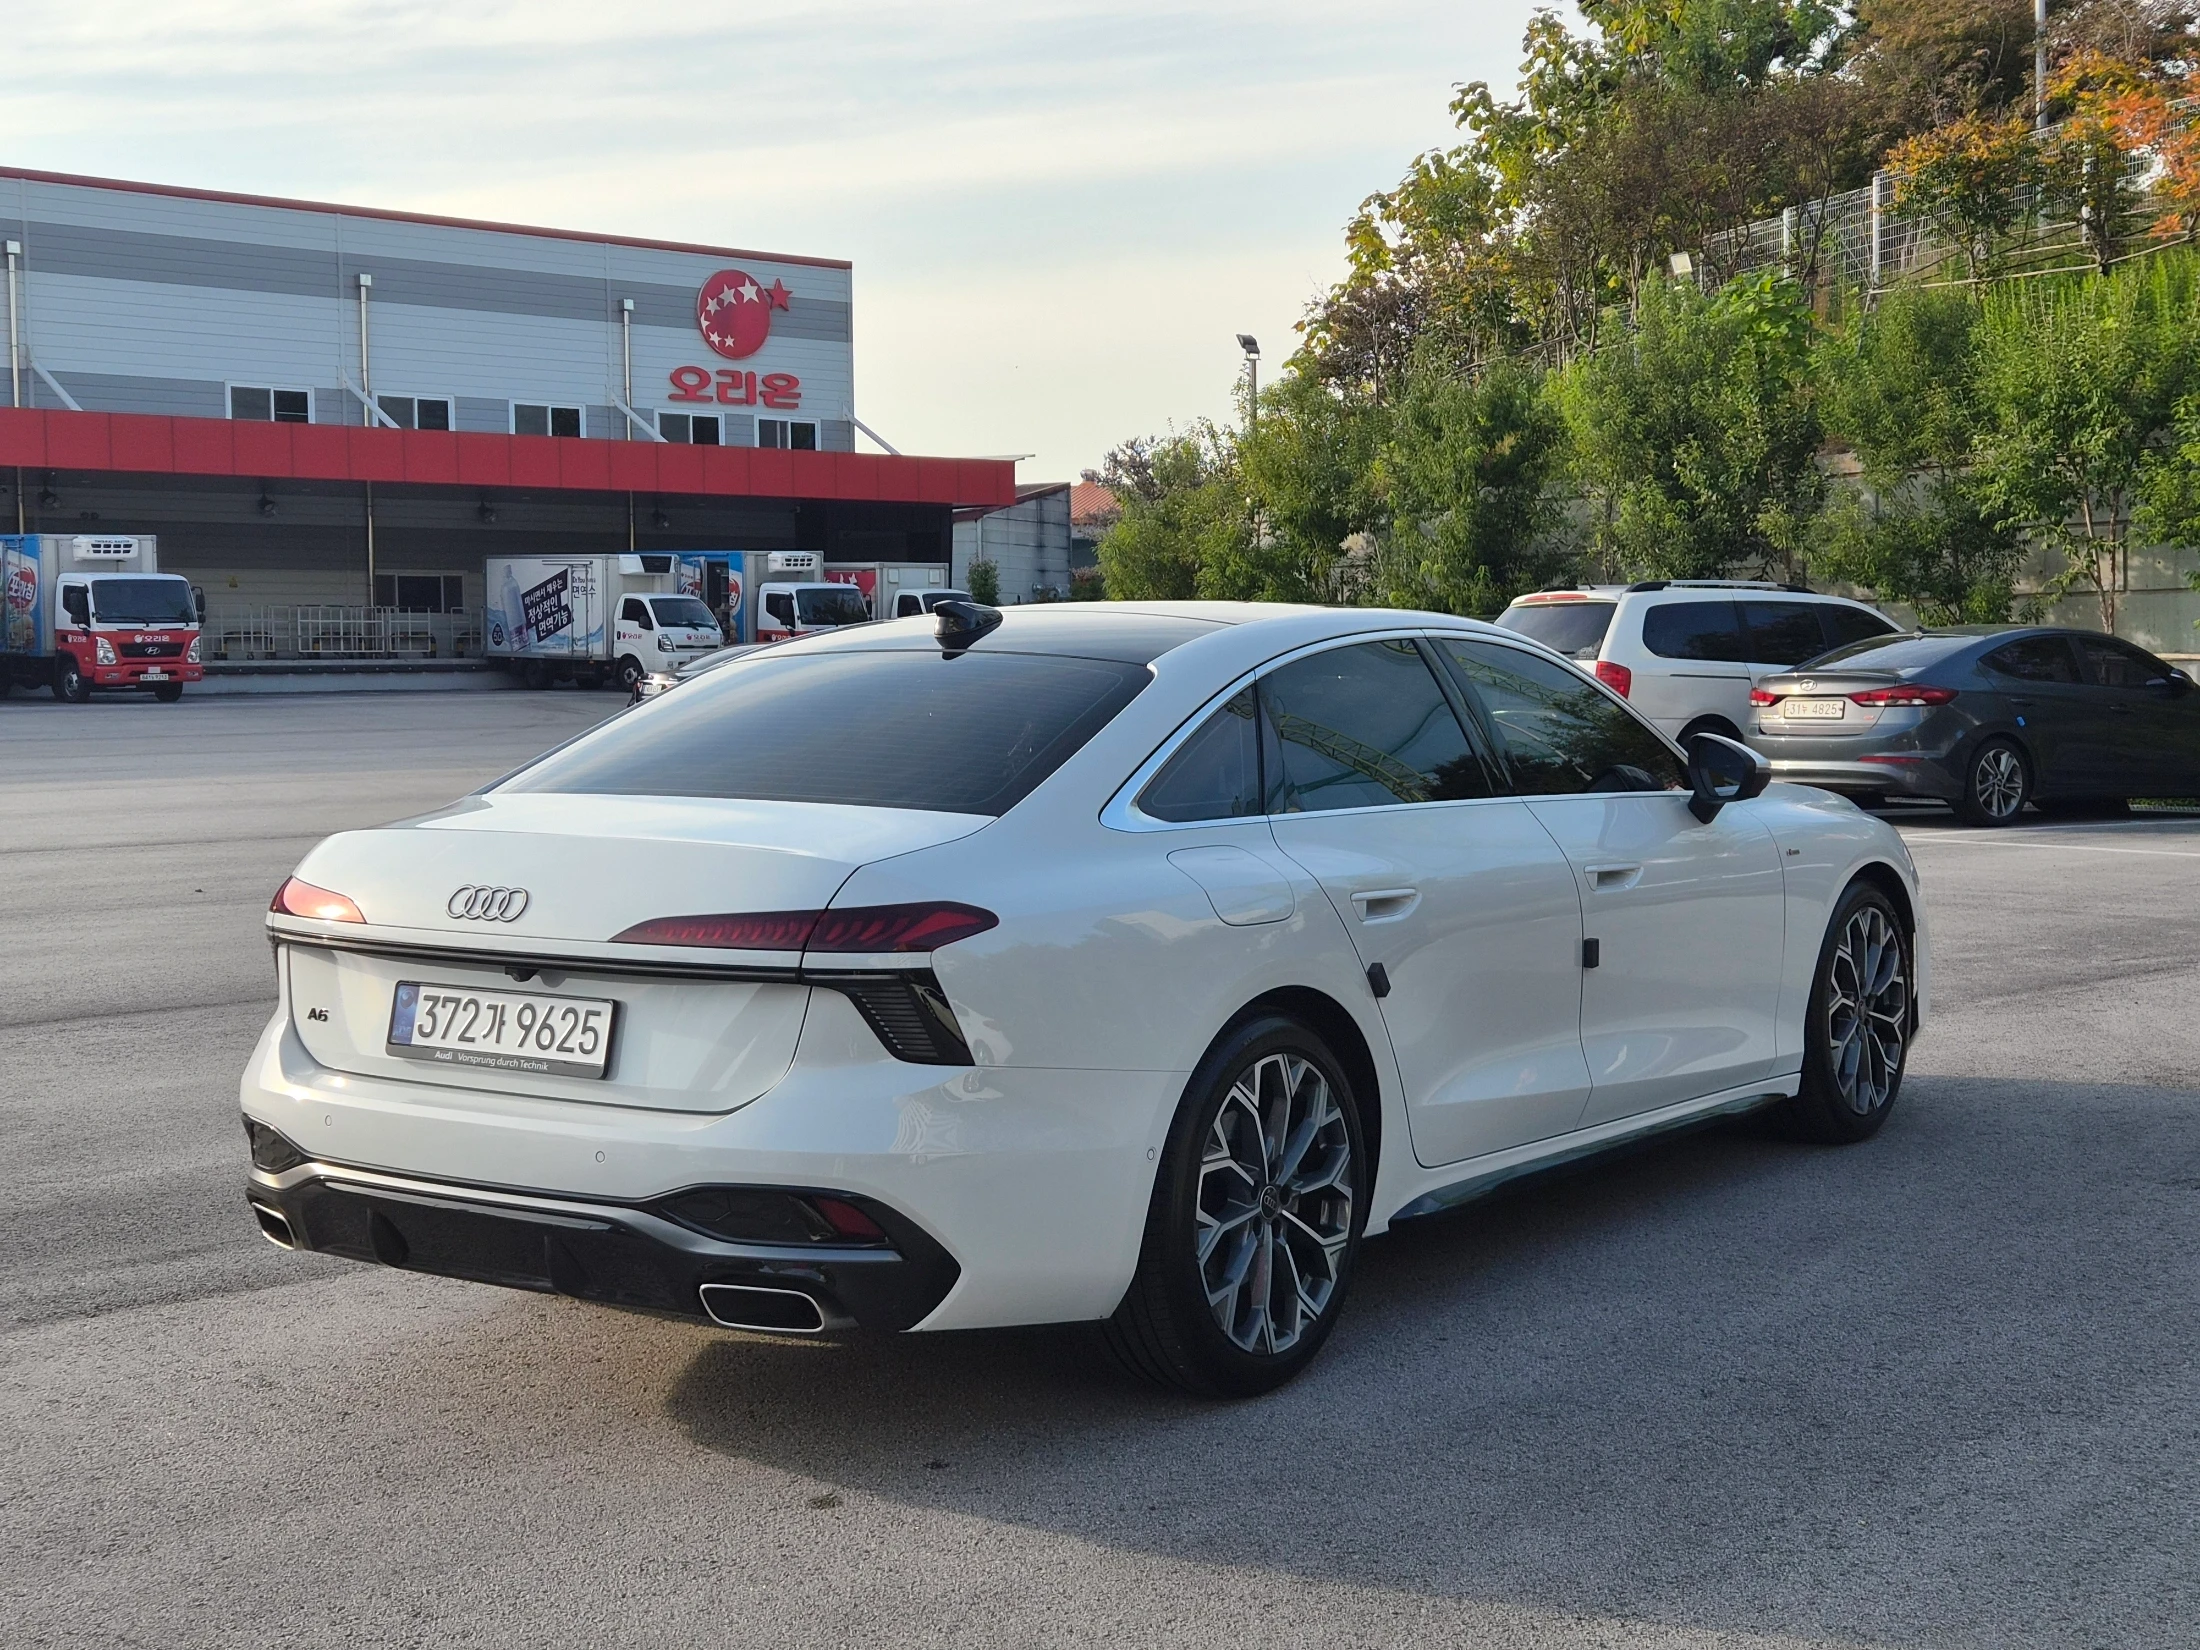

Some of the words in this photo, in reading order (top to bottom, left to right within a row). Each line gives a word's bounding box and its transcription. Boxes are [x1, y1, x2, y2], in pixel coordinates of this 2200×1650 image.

[668, 365, 802, 409] 오리온
[524, 586, 546, 606] 마시면서
[528, 594, 559, 624] 정상적인
[538, 609, 569, 637] 면역기능
[1812, 703, 1837, 715] 4825
[307, 1007, 329, 1022] A6
[417, 994, 506, 1044] 372가
[516, 1002, 602, 1055] 9625
[434, 1050, 453, 1060] Audi
[457, 1052, 496, 1067] Vorsprung
[496, 1057, 519, 1068] durch
[519, 1059, 549, 1071] Technik
